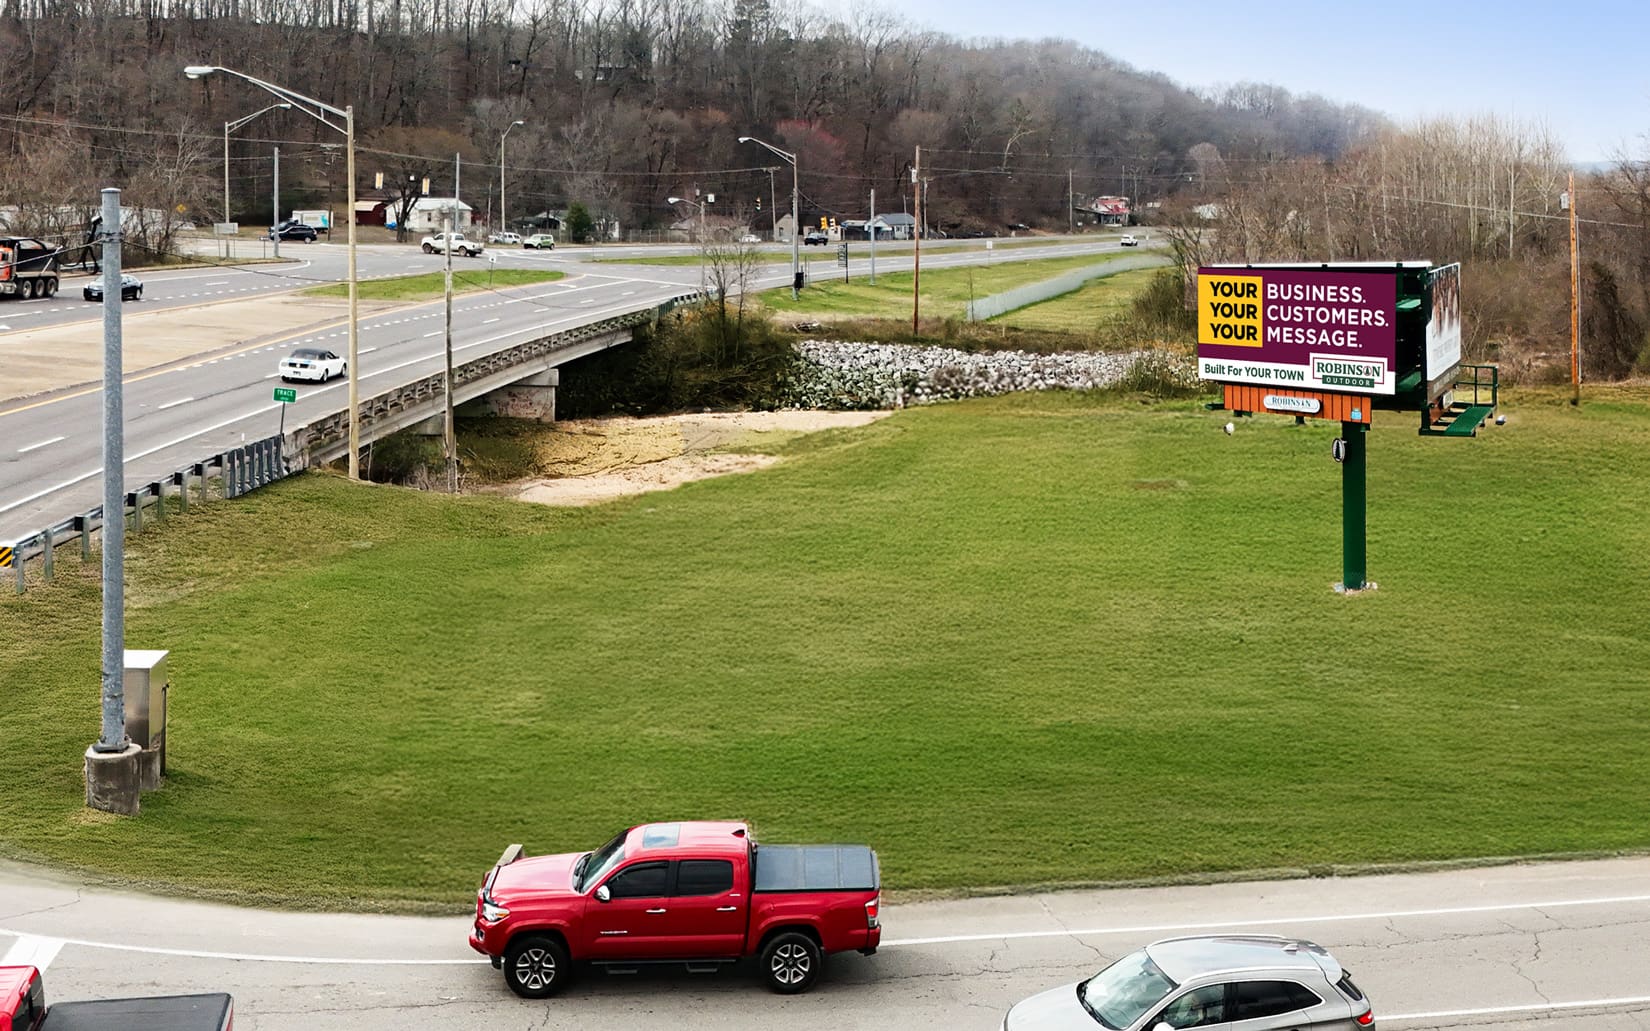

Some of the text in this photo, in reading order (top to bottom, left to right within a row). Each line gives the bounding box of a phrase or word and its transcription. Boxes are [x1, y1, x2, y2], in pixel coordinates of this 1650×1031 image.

[1210, 281, 1366, 303] YOUR BUSINESS.
[1210, 302, 1389, 327] YOUR CUSTOMERS.
[1210, 323, 1362, 348] YOUR MESSAGE.
[1204, 363, 1304, 381] Built For YOUR TOWN
[1316, 362, 1381, 377] ROBINSON
[1326, 377, 1370, 386] OUTDOOR
